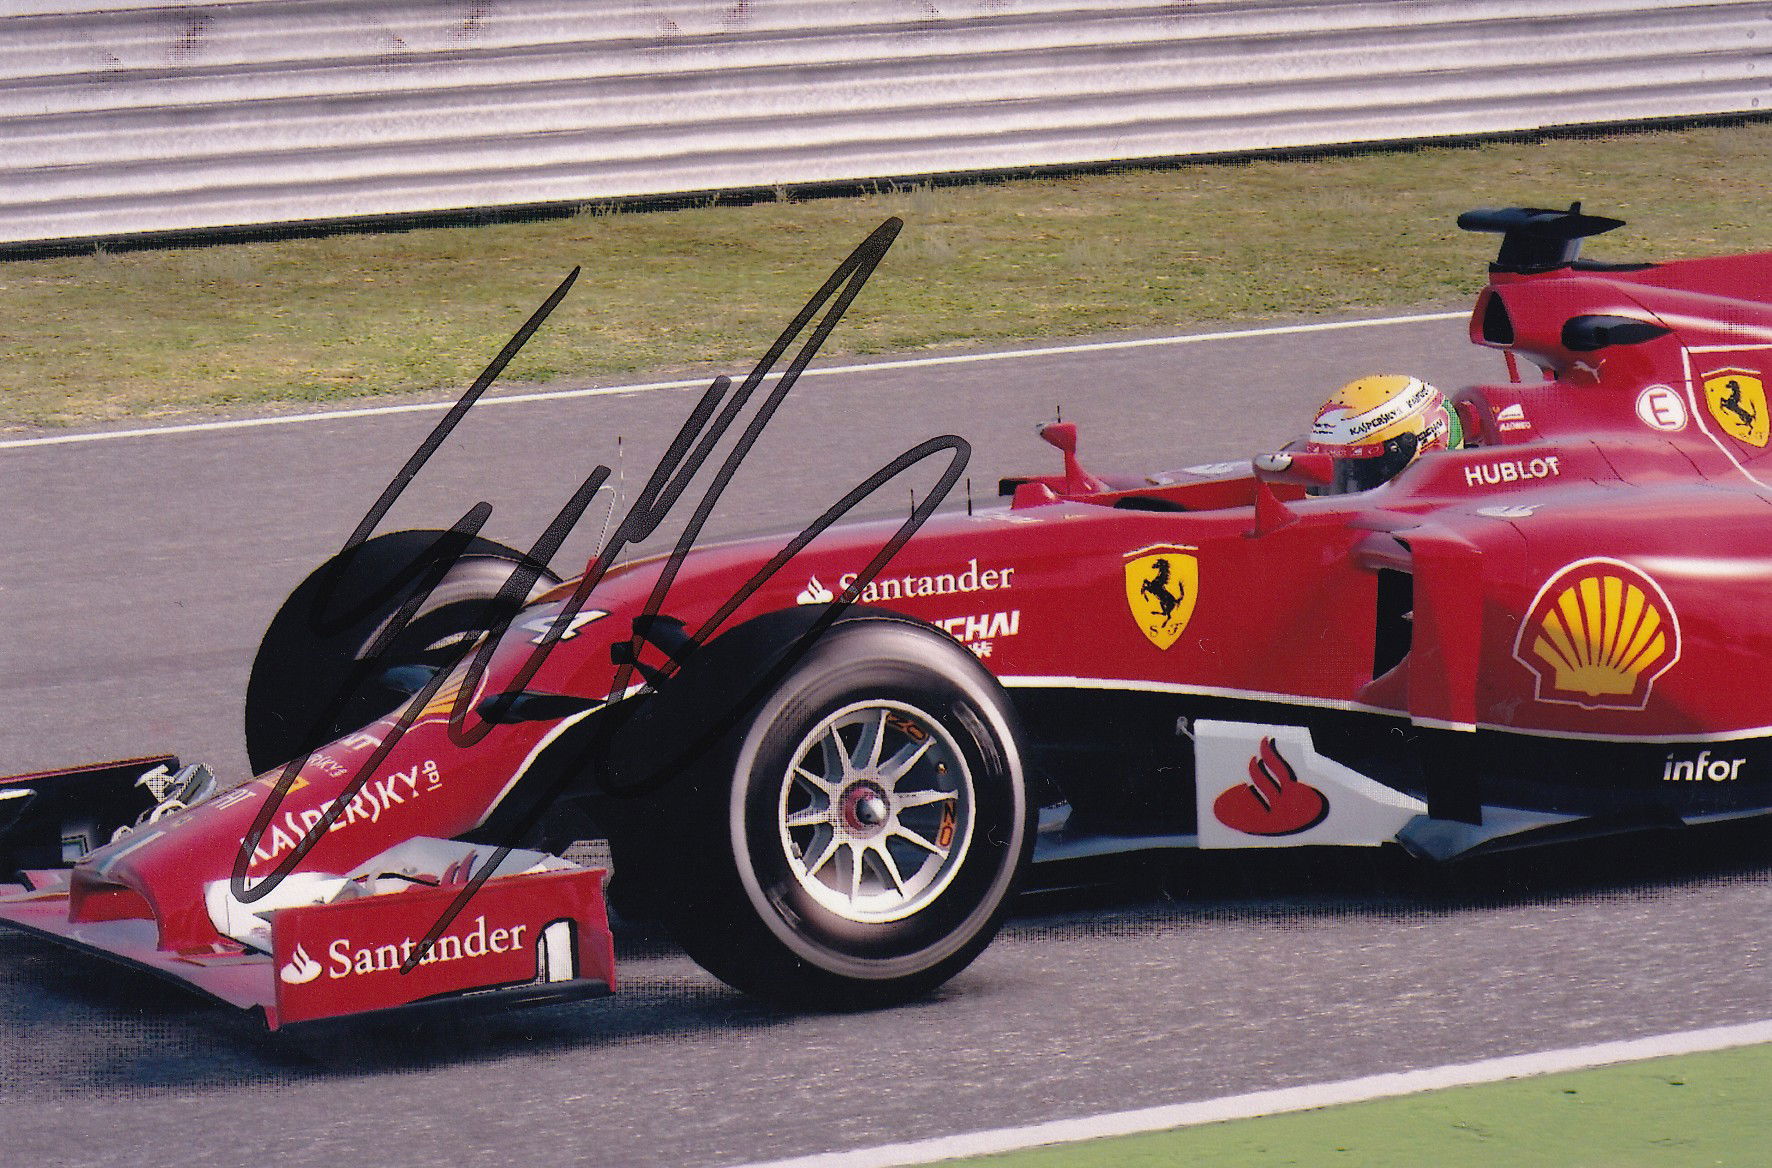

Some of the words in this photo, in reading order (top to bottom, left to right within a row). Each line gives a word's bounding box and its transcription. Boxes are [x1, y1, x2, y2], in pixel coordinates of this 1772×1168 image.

[1648, 393, 1676, 426] E
[1464, 456, 1561, 487] HUBLOT
[838, 558, 1015, 604] Santander
[1662, 750, 1746, 782] infor
[239, 764, 421, 868] KASPERSKY
[421, 759, 443, 792] lab
[328, 915, 527, 980] Santander
